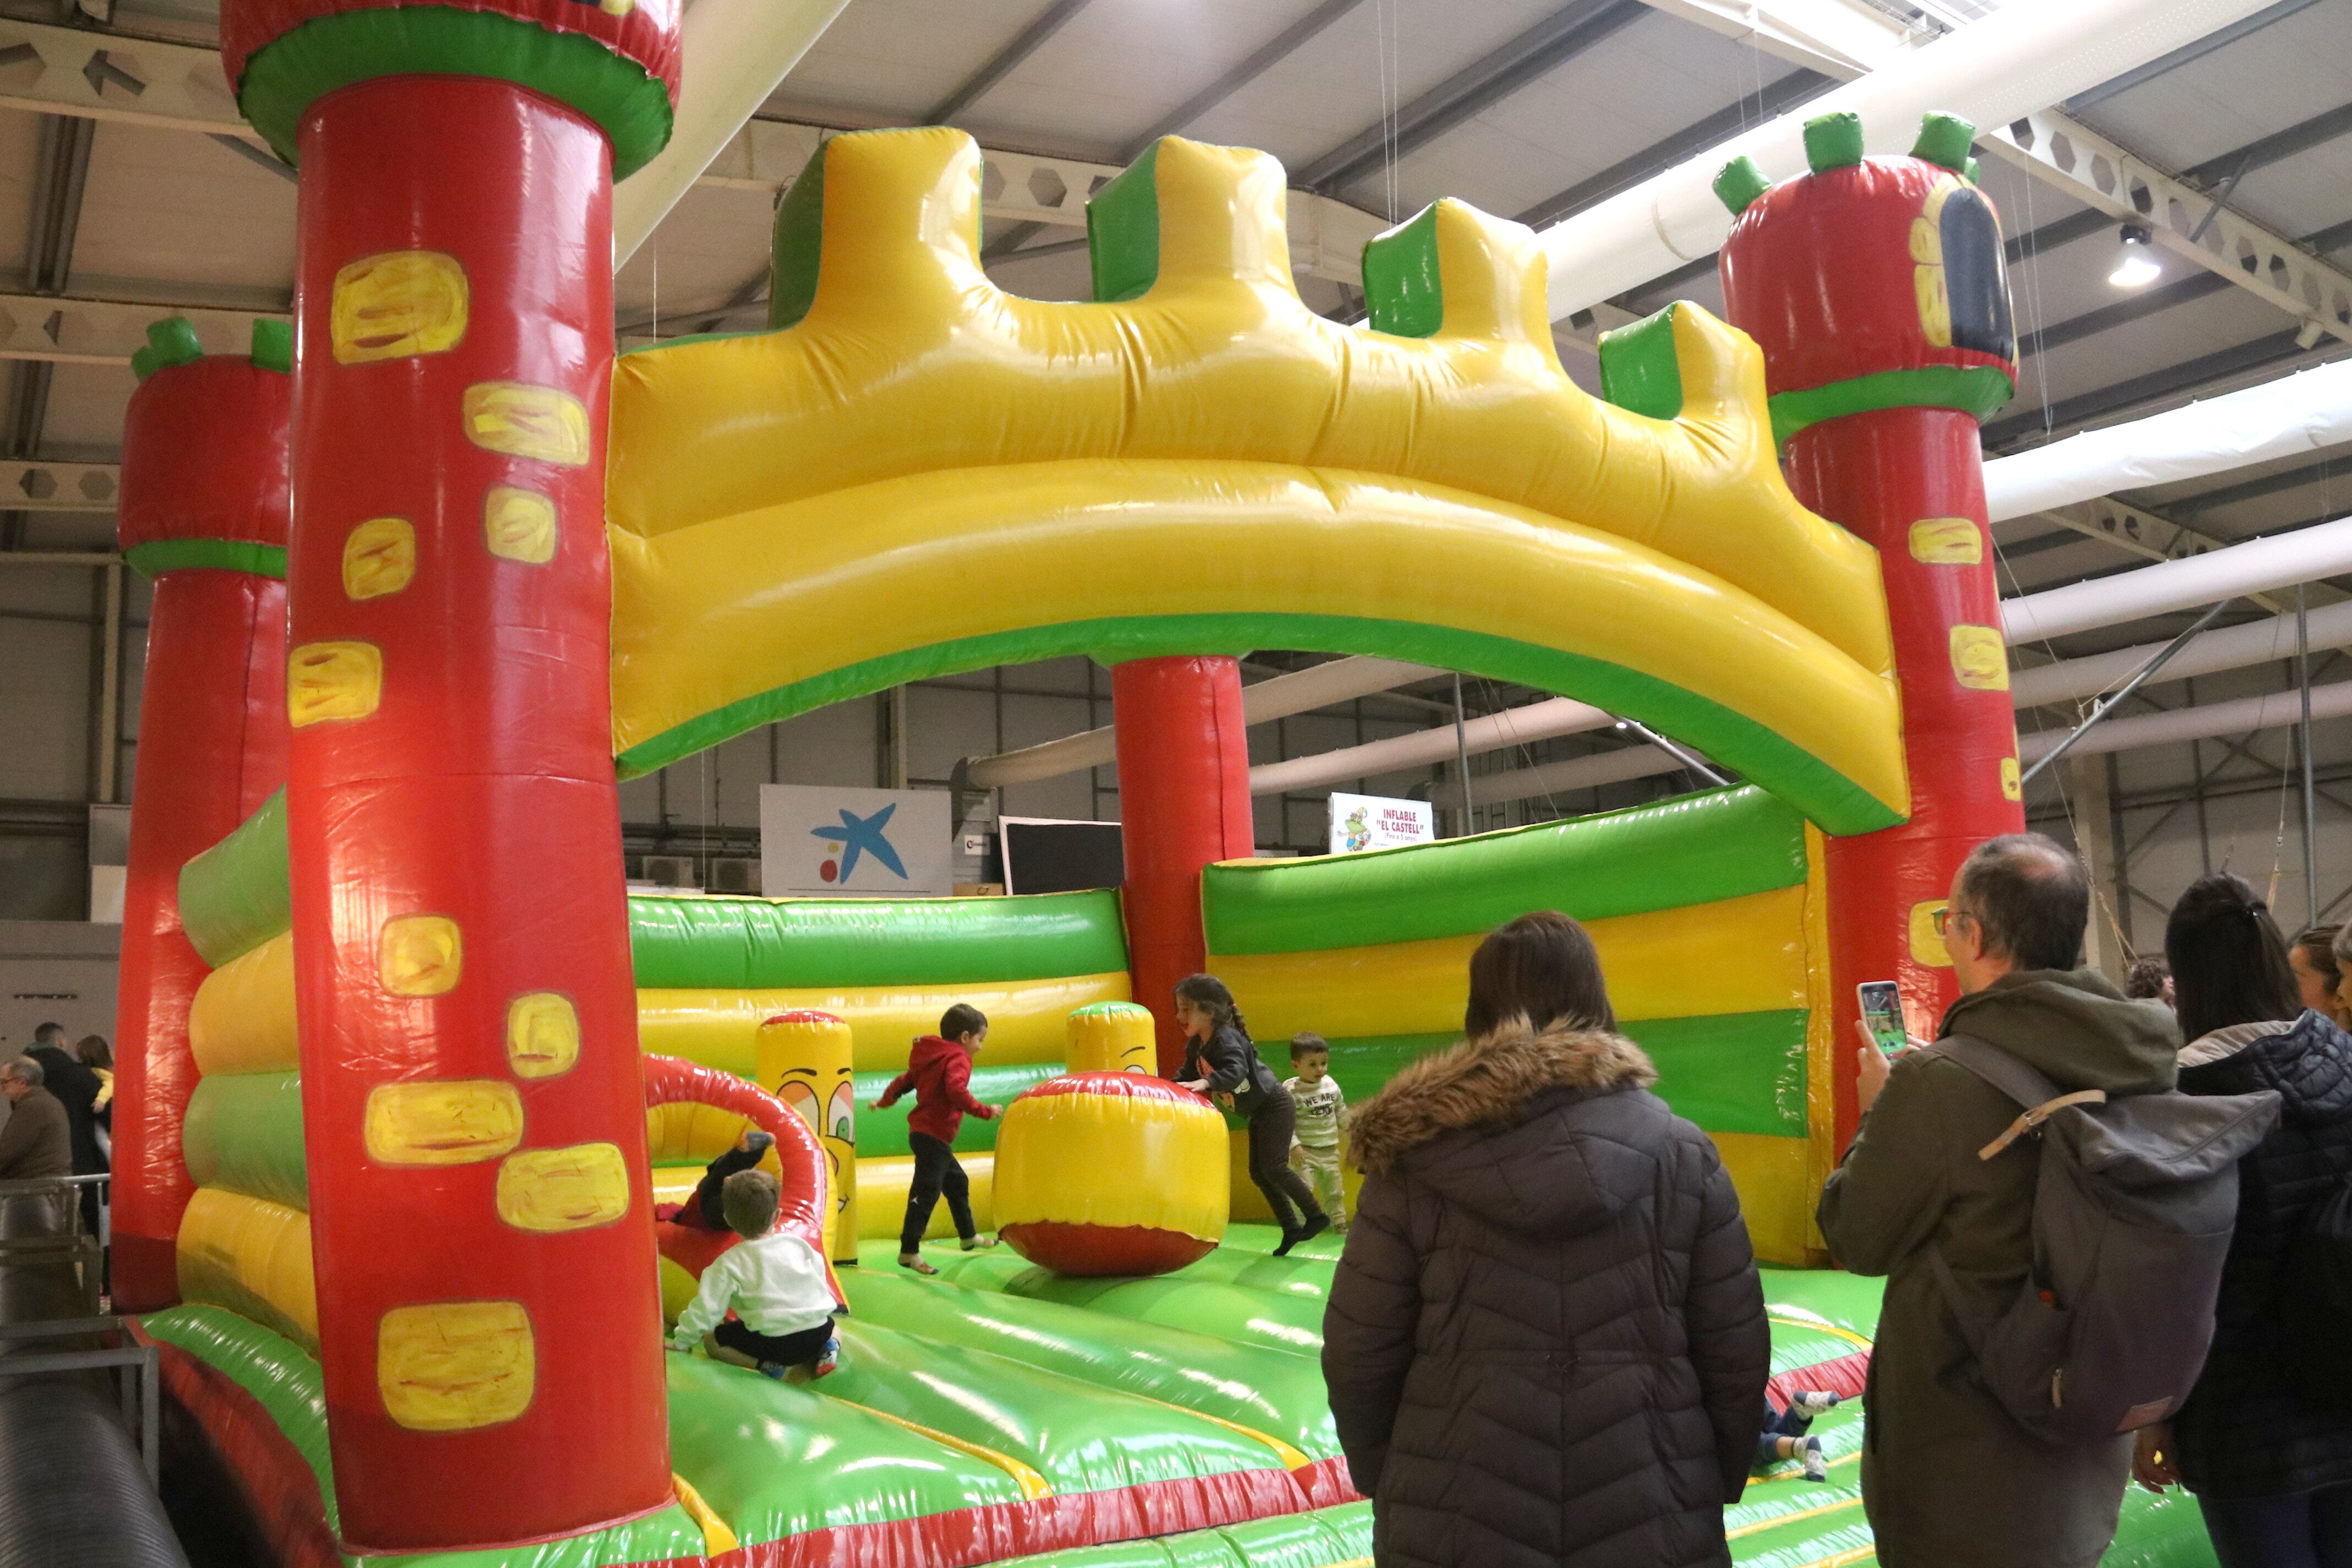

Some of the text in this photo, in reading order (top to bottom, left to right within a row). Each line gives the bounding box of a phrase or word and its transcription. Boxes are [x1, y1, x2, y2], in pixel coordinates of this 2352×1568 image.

[1384, 809, 1416, 821] INFLABLE
[1376, 820, 1389, 830] "EL
[1303, 1092, 1335, 1107] WE ARE
